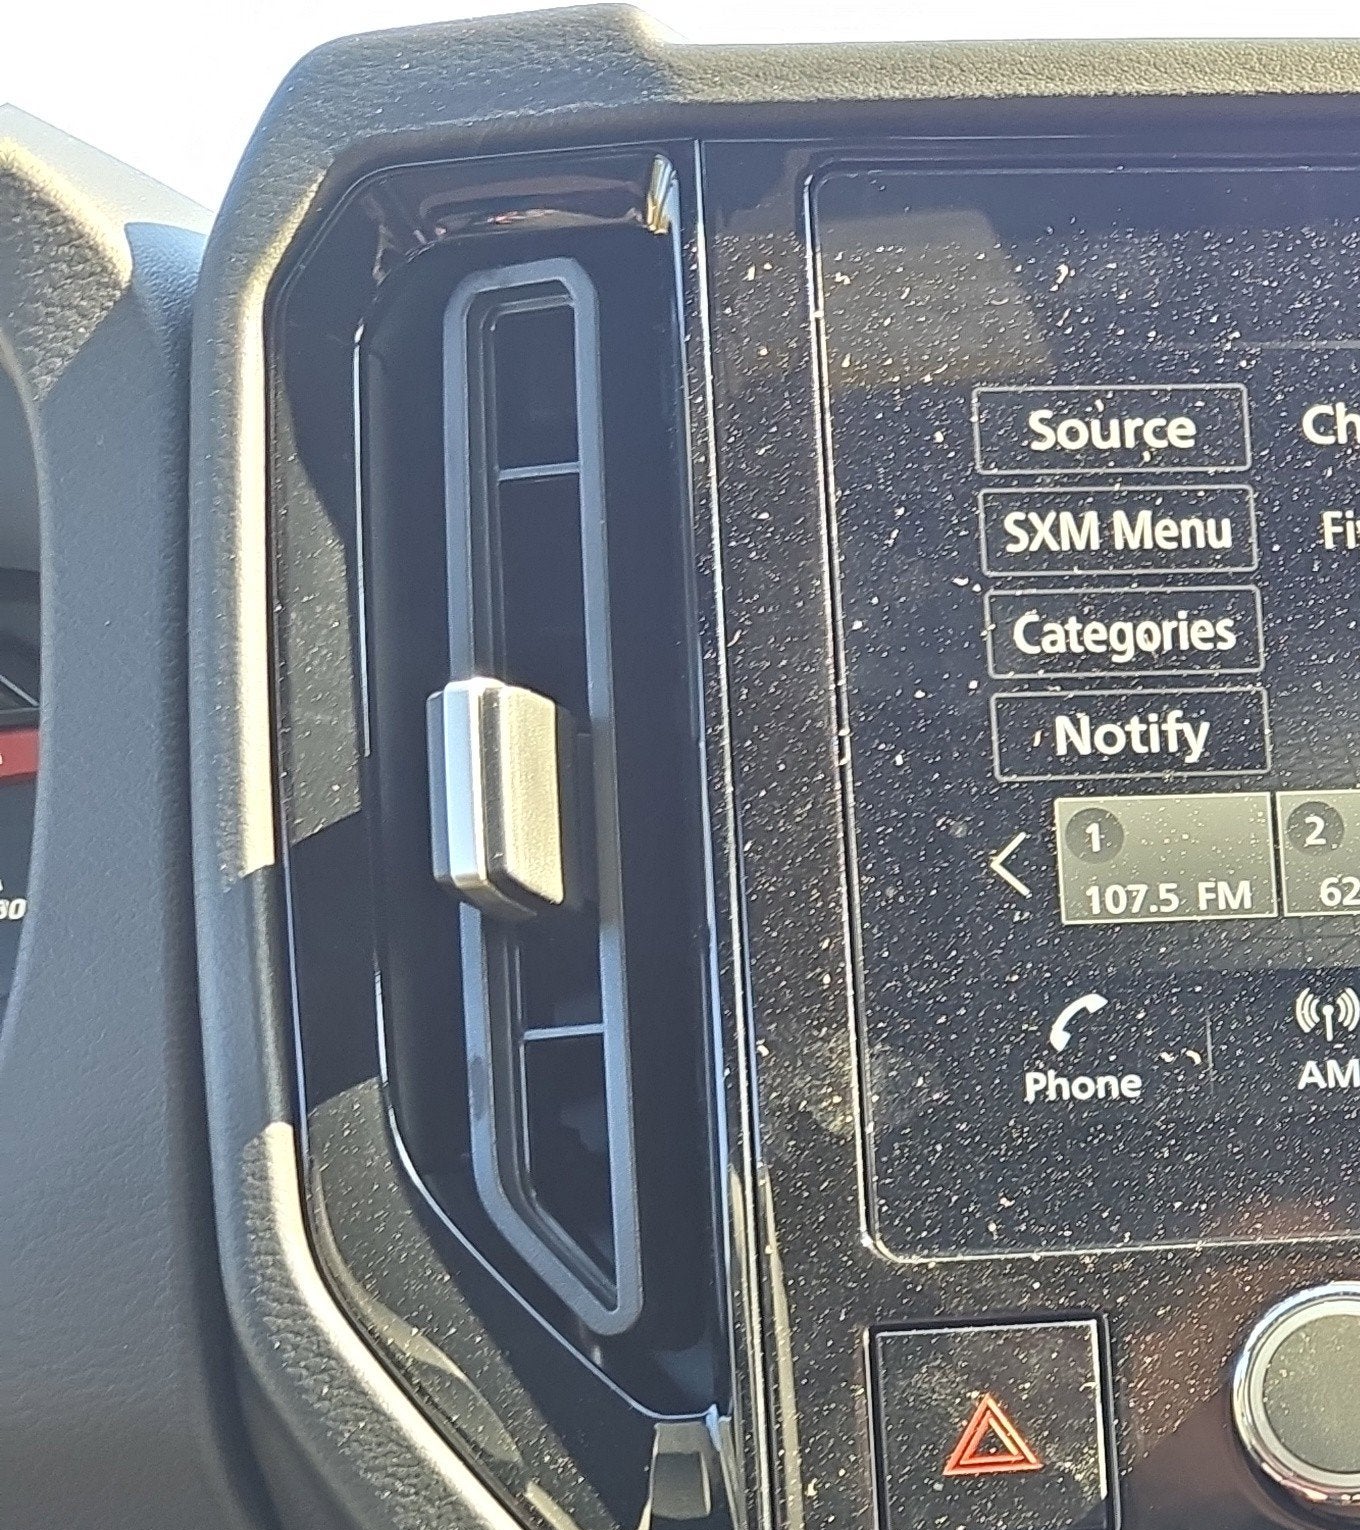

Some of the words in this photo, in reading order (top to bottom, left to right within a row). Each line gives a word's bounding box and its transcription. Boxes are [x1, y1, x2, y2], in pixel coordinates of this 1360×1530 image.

[1029, 409, 1197, 452] Source
[1004, 511, 1099, 553] SXM
[1114, 510, 1232, 550] Menu
[1014, 610, 1236, 663] Categories
[1055, 712, 1211, 760] Notify
[1084, 823, 1101, 853] 1
[1305, 816, 1326, 846] 2
[1085, 883, 1180, 914] 107.5
[1199, 881, 1252, 910] FM
[1025, 1069, 1143, 1103] Phone
[1298, 1058, 1360, 1090] AM
